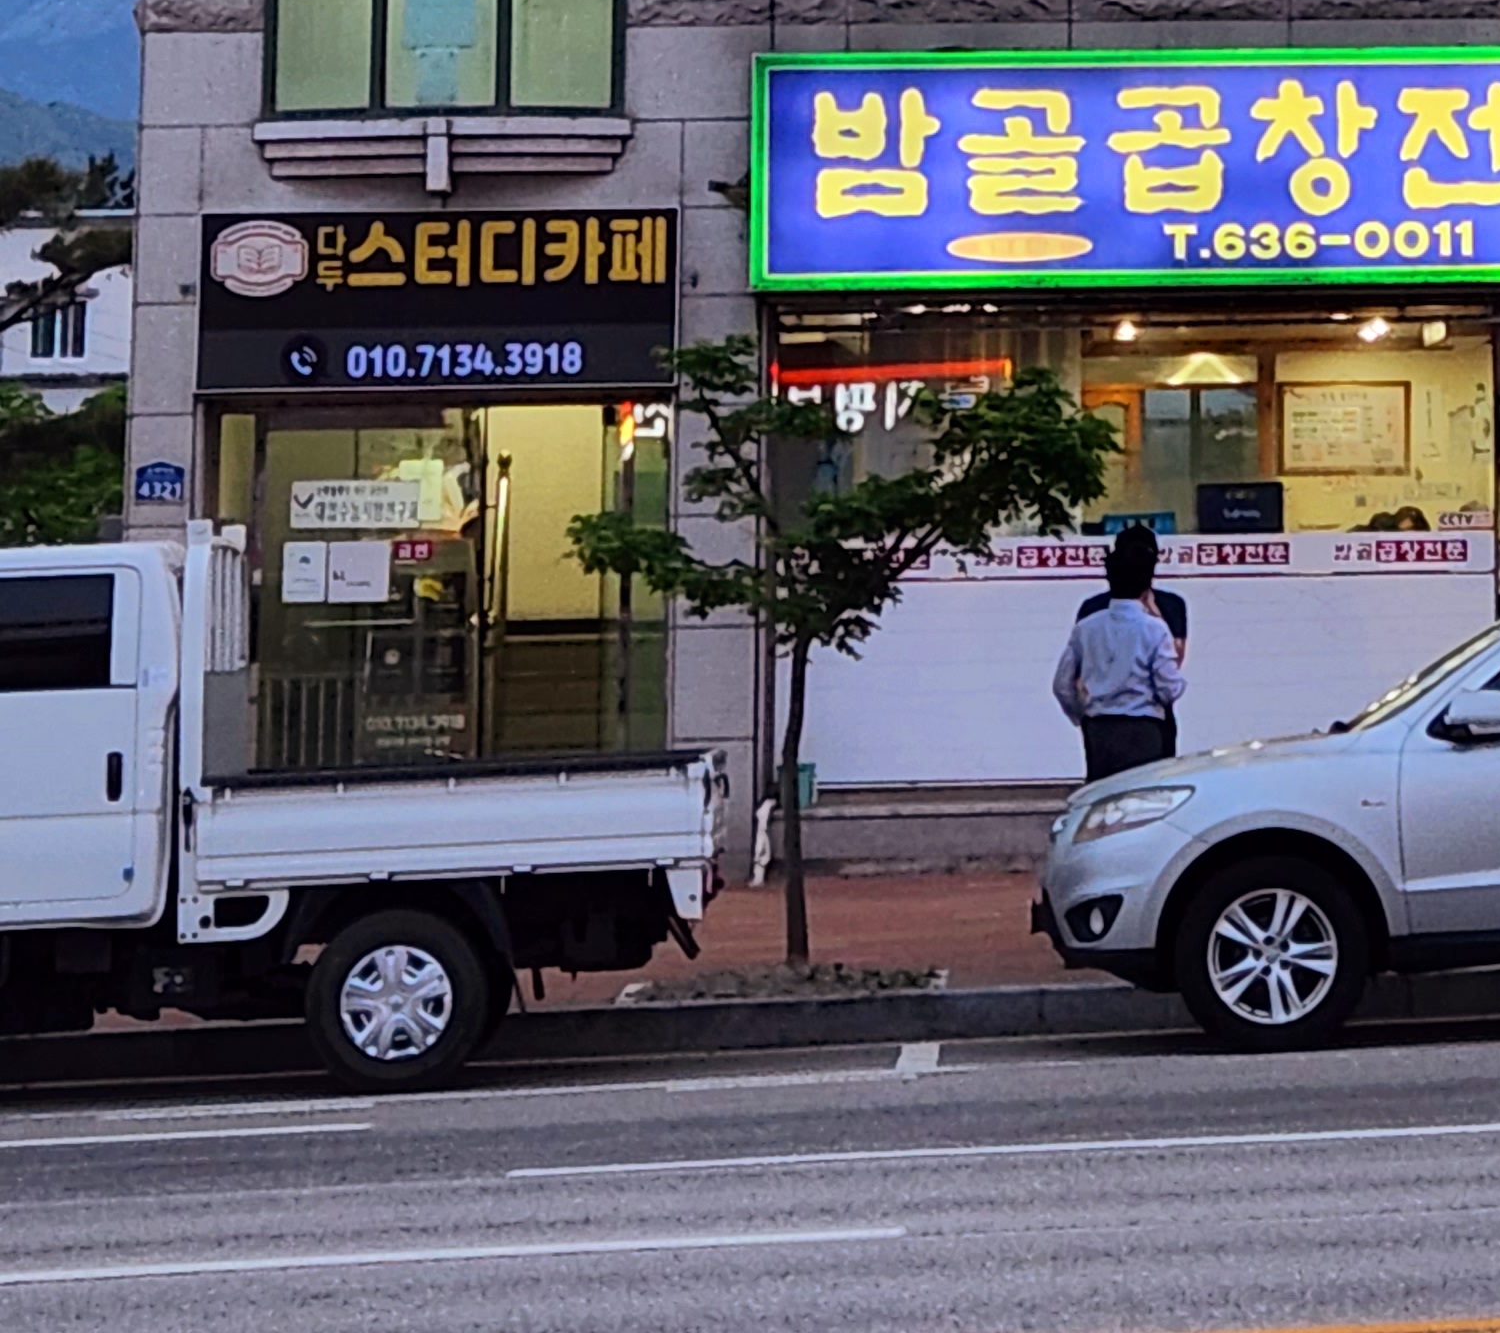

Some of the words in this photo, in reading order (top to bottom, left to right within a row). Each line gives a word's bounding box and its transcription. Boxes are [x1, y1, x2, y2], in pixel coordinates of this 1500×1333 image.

[346, 215, 667, 288] 스터디카페
[1161, 220, 1474, 261] T.636-0011
[346, 340, 583, 379] 010.7134.3918
[138, 481, 182, 500] 4321
[1438, 511, 1474, 526] CCTV
